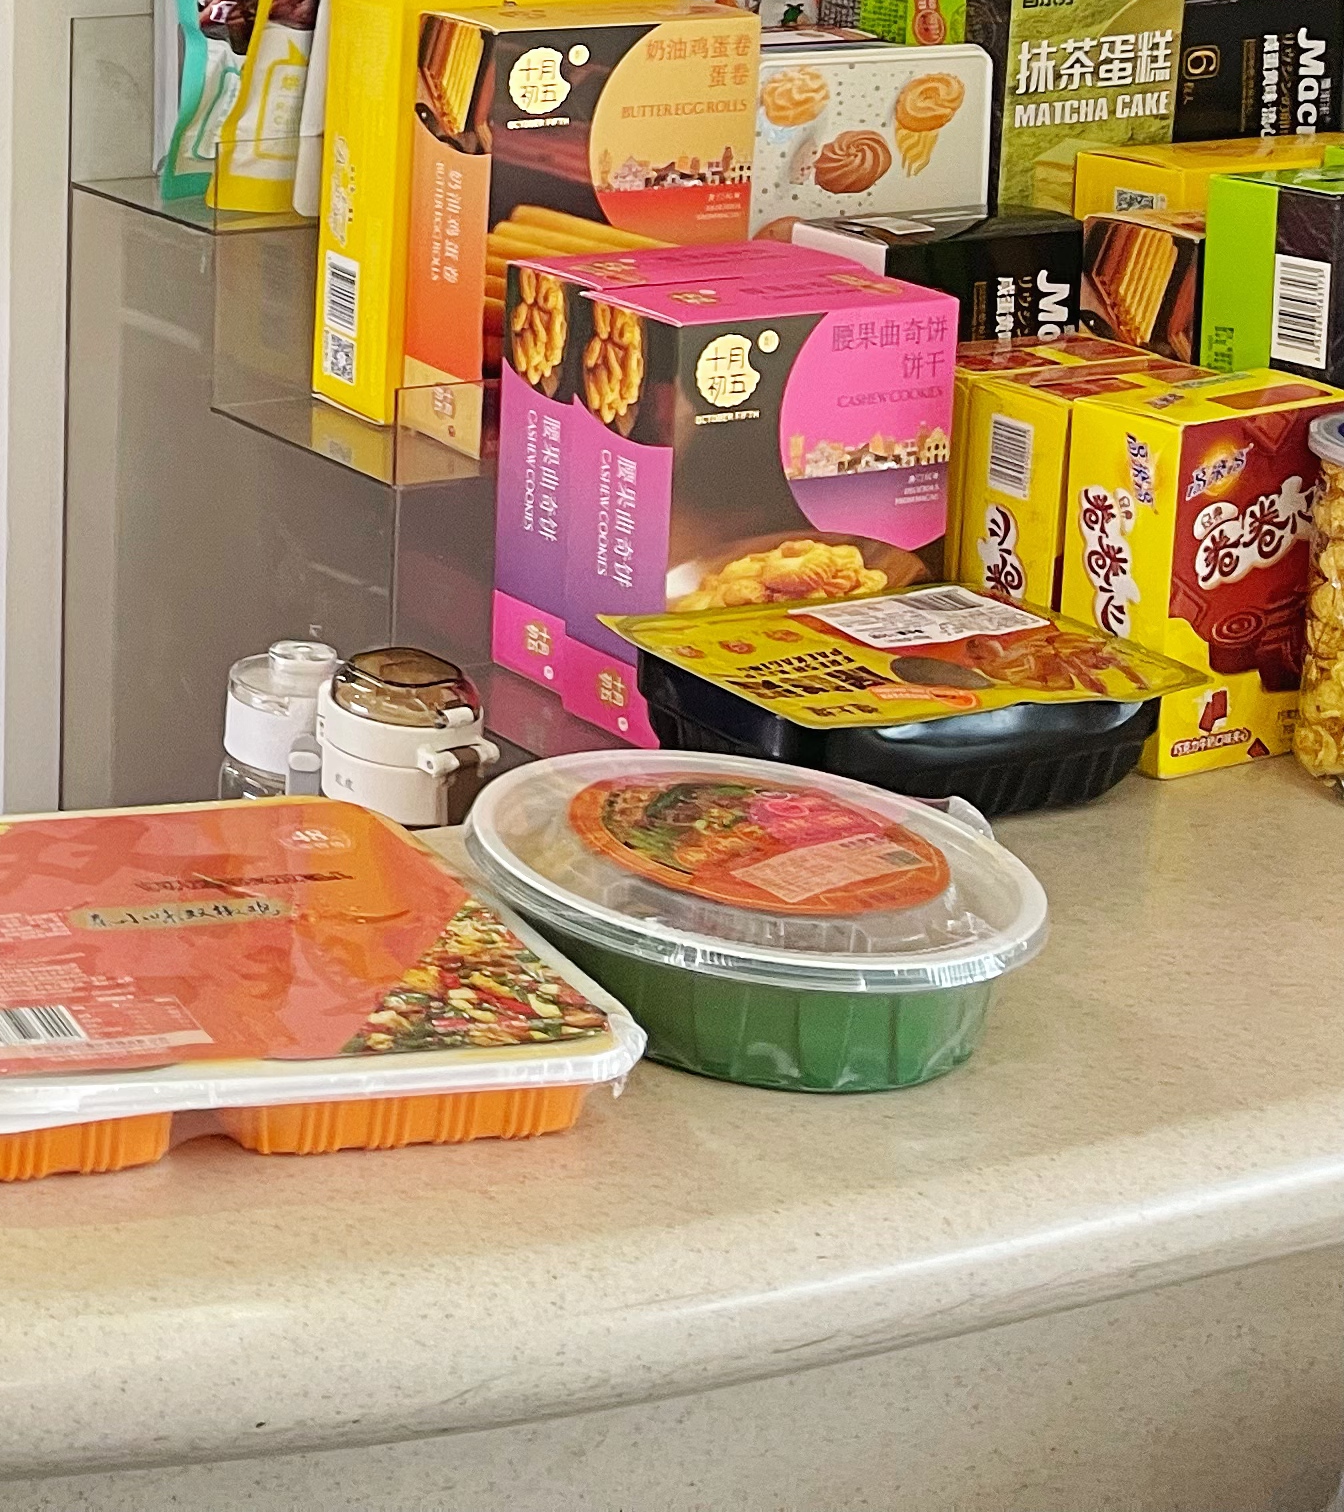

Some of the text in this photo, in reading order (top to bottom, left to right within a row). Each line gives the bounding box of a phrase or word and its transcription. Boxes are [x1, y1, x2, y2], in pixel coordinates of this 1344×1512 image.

[647, 35, 750, 61] 奶油鸡蛋卷
[519, 59, 556, 80] 十月
[1016, 30, 1172, 94] 抹茶蛋糕
[710, 64, 750, 88] 蛋卷
[521, 84, 558, 105] 初五
[622, 103, 674, 120] BUTTER
[711, 99, 747, 114] ROLLS
[1015, 91, 1170, 128] MATCHA CAKE
[833, 315, 948, 352] 腰果曲奇饼
[706, 347, 744, 371] 十月
[902, 351, 945, 379] 饼干
[708, 375, 747, 403] 初五
